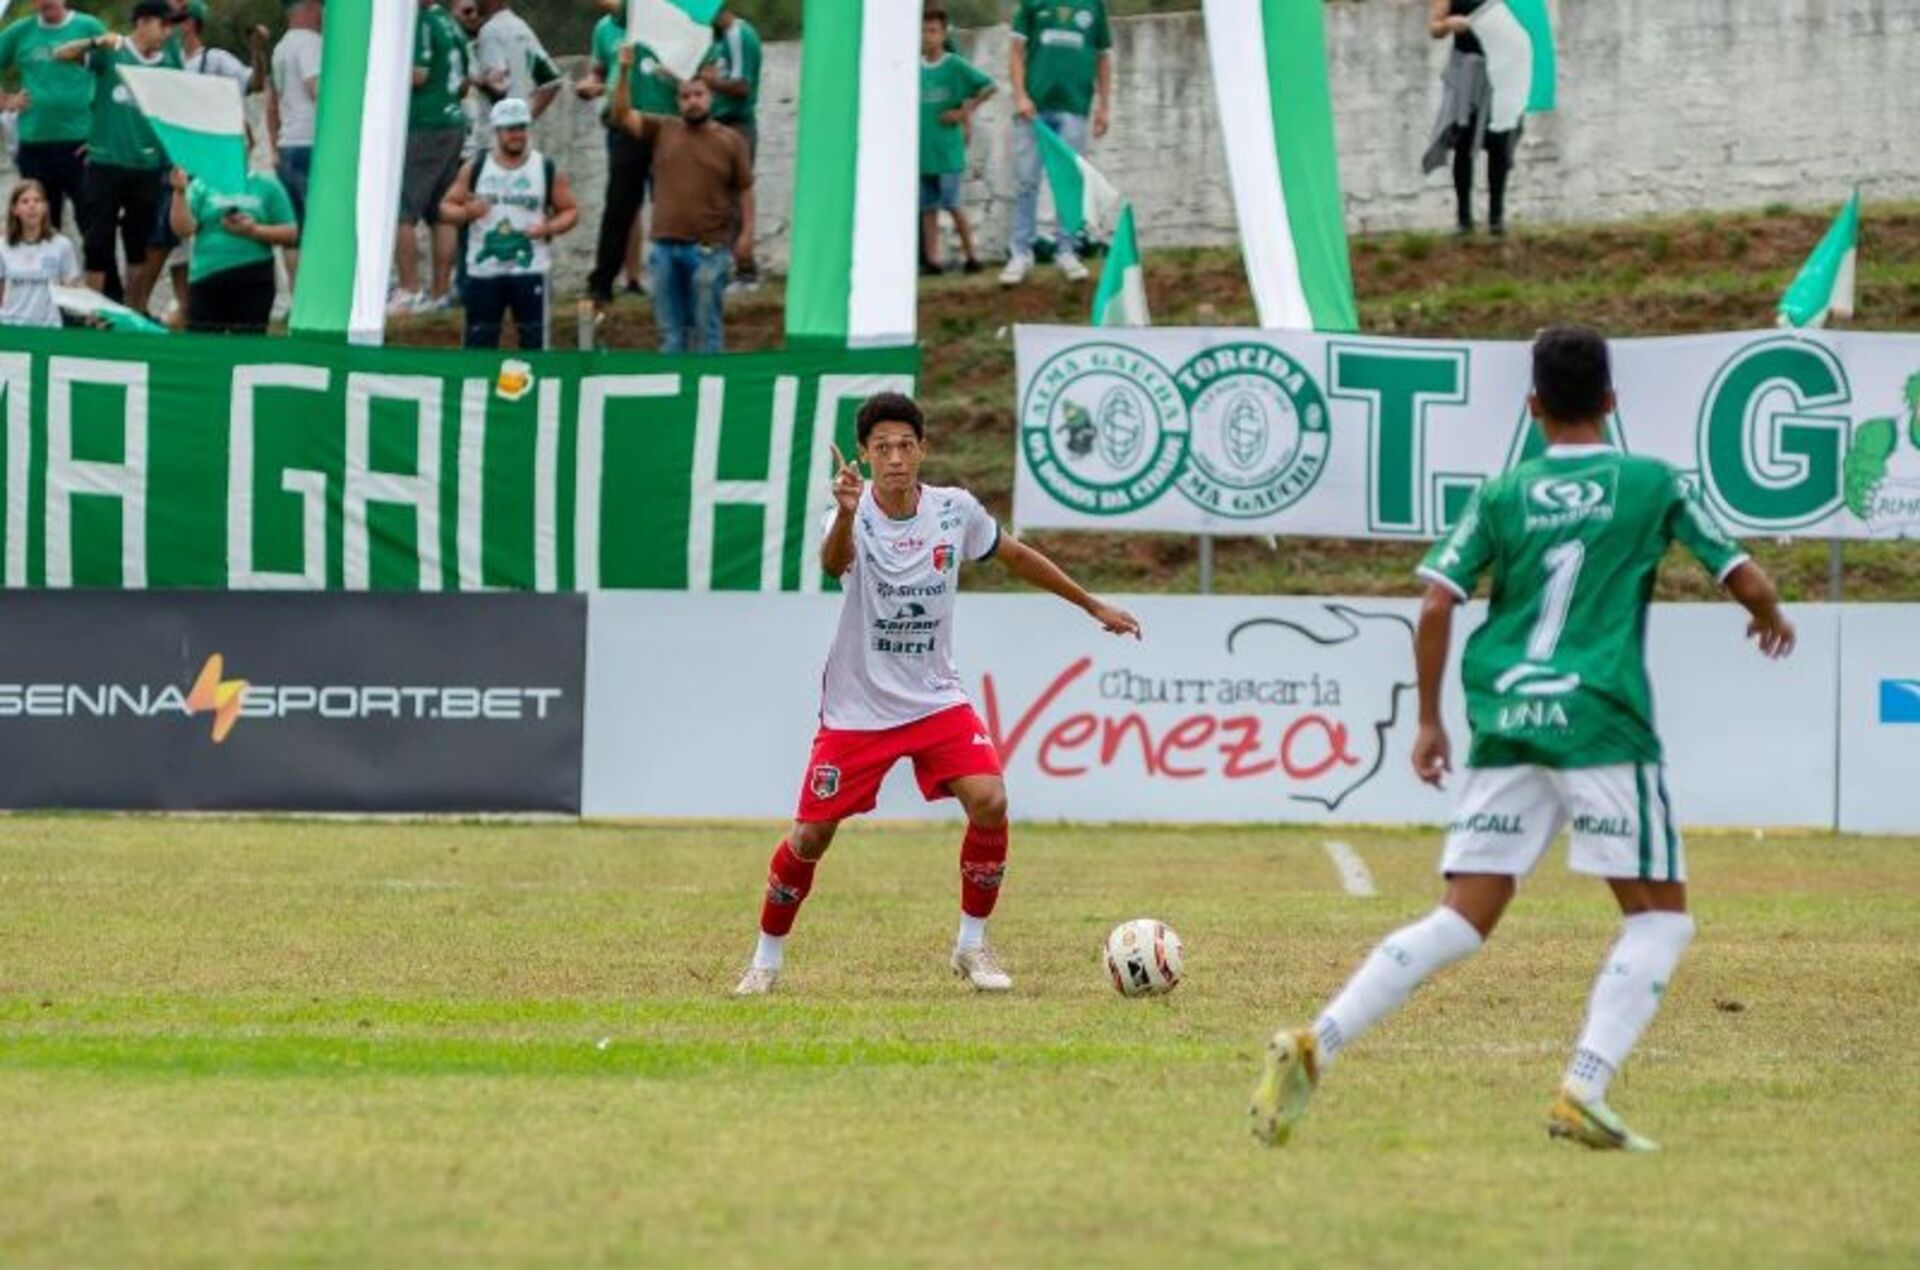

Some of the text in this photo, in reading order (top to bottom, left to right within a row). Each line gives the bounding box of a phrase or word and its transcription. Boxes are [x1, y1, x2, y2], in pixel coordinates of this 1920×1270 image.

[1176, 349, 1306, 395] TORCIDA
[1526, 539, 1585, 661] 1
[0, 684, 194, 717] SENNA
[1099, 667, 1341, 706] Churrascaria
[982, 657, 1359, 780] Veneza
